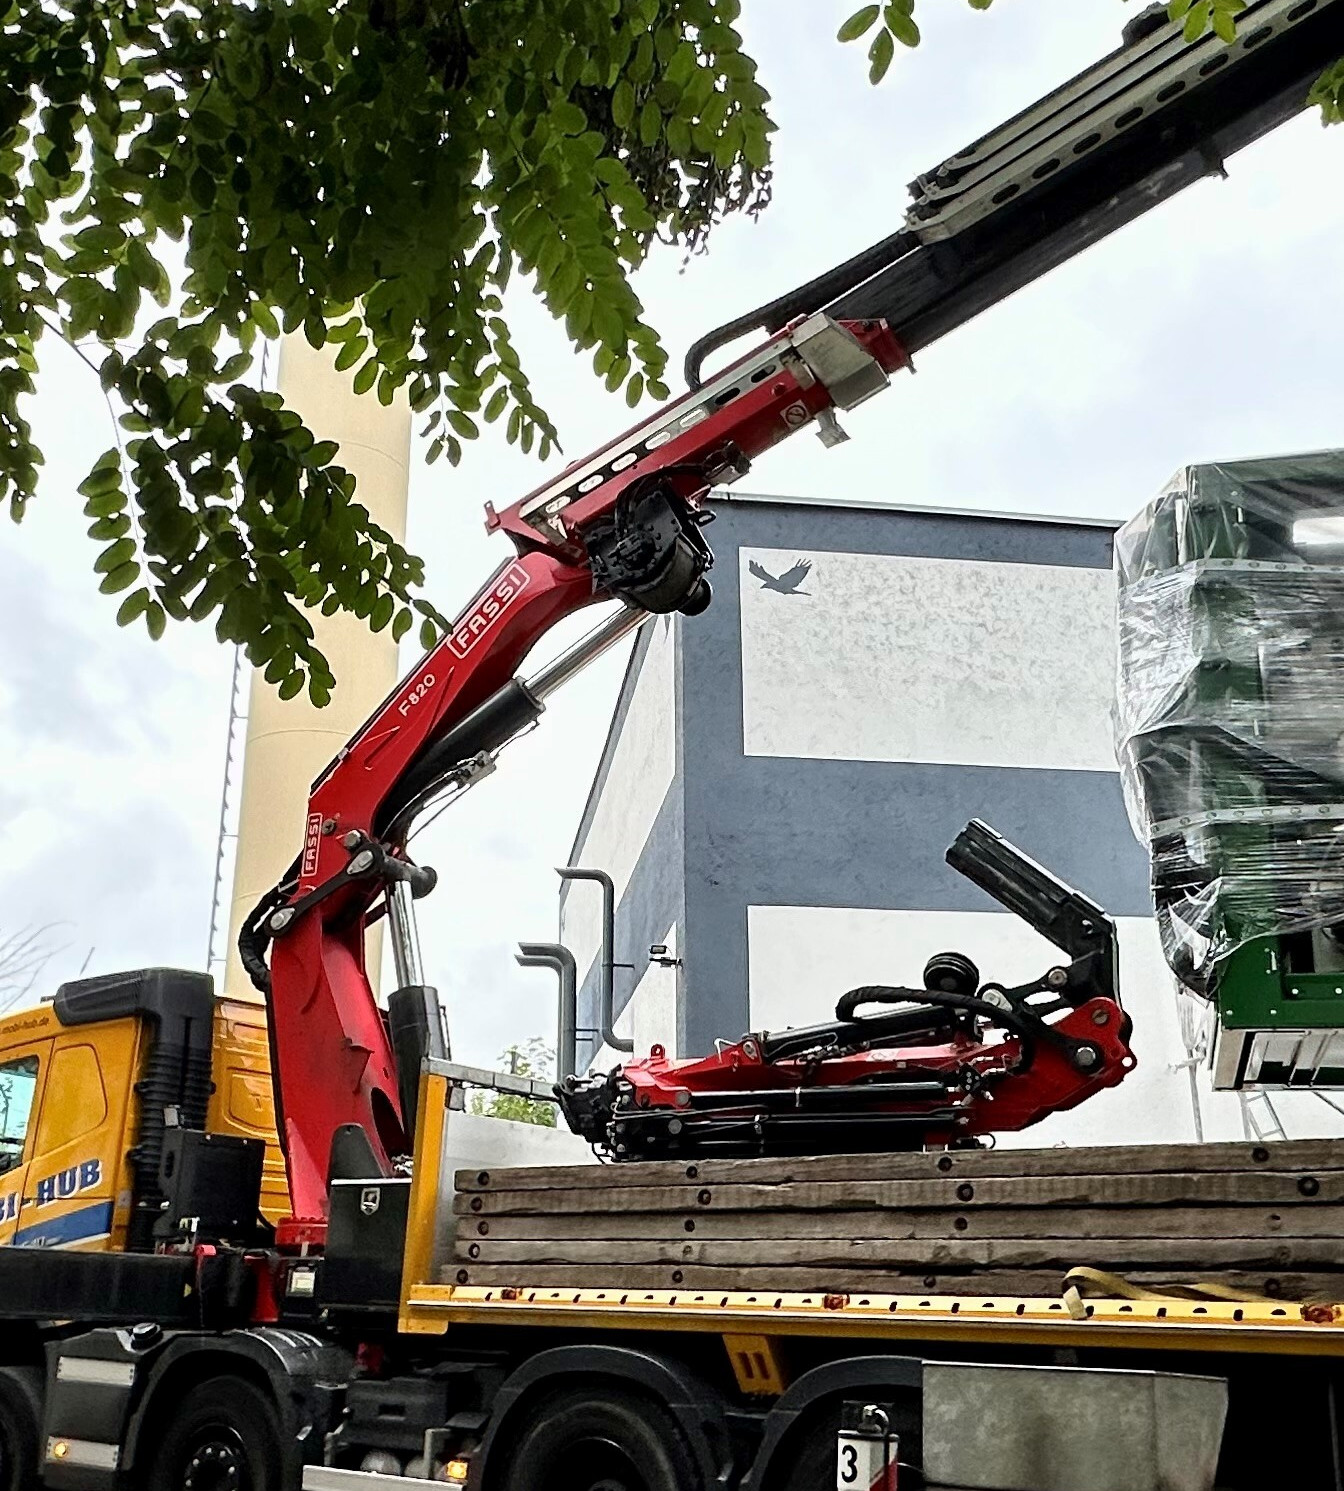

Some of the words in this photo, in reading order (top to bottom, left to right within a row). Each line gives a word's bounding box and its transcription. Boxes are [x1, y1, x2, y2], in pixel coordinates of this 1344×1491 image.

[456, 574, 521, 649] FASSI
[398, 673, 436, 717] F820
[305, 818, 319, 871] FASSI
[841, 1444, 859, 1483] 3
